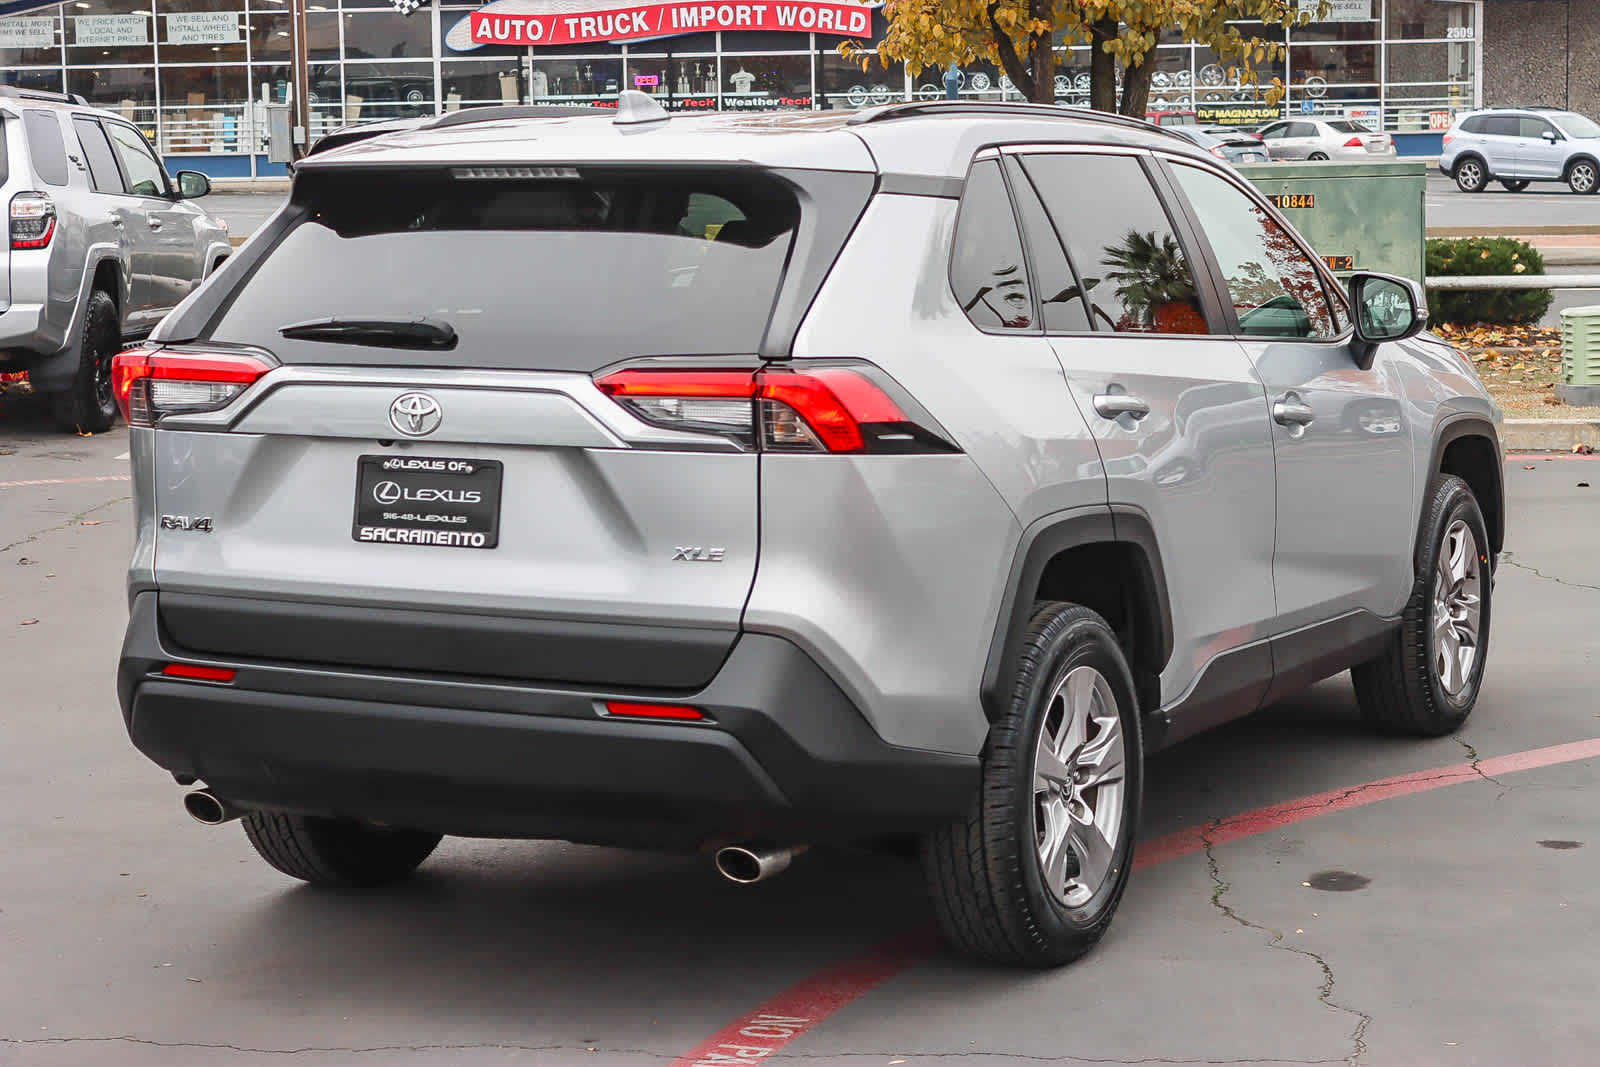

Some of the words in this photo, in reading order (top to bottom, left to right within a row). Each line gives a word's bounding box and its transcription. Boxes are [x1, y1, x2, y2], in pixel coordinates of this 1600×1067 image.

[175, 15, 187, 23] WE
[211, 14, 229, 22] AND
[476, 17, 544, 41] AUTO
[564, 10, 650, 39] TRUCK
[671, 4, 768, 28] IMPORT
[775, 5, 867, 33] WORLD
[89, 26, 115, 34] LOCAL
[116, 26, 133, 34] AND
[168, 24, 201, 33] INSTALL
[202, 23, 237, 32] WHEELS
[1446, 27, 1474, 39] 2509
[182, 33, 199, 41] AND
[200, 32, 225, 41] TIRES
[725, 97, 811, 108] WeatherTech
[1216, 108, 1280, 118] MAGNAFLOW
[400, 459, 446, 470] LEXUS
[448, 461, 467, 471] OF
[403, 487, 482, 503] LEXUS
[161, 514, 213, 533] RAV4
[360, 526, 486, 547] SACRAMENTO
[671, 546, 726, 562] XLE
